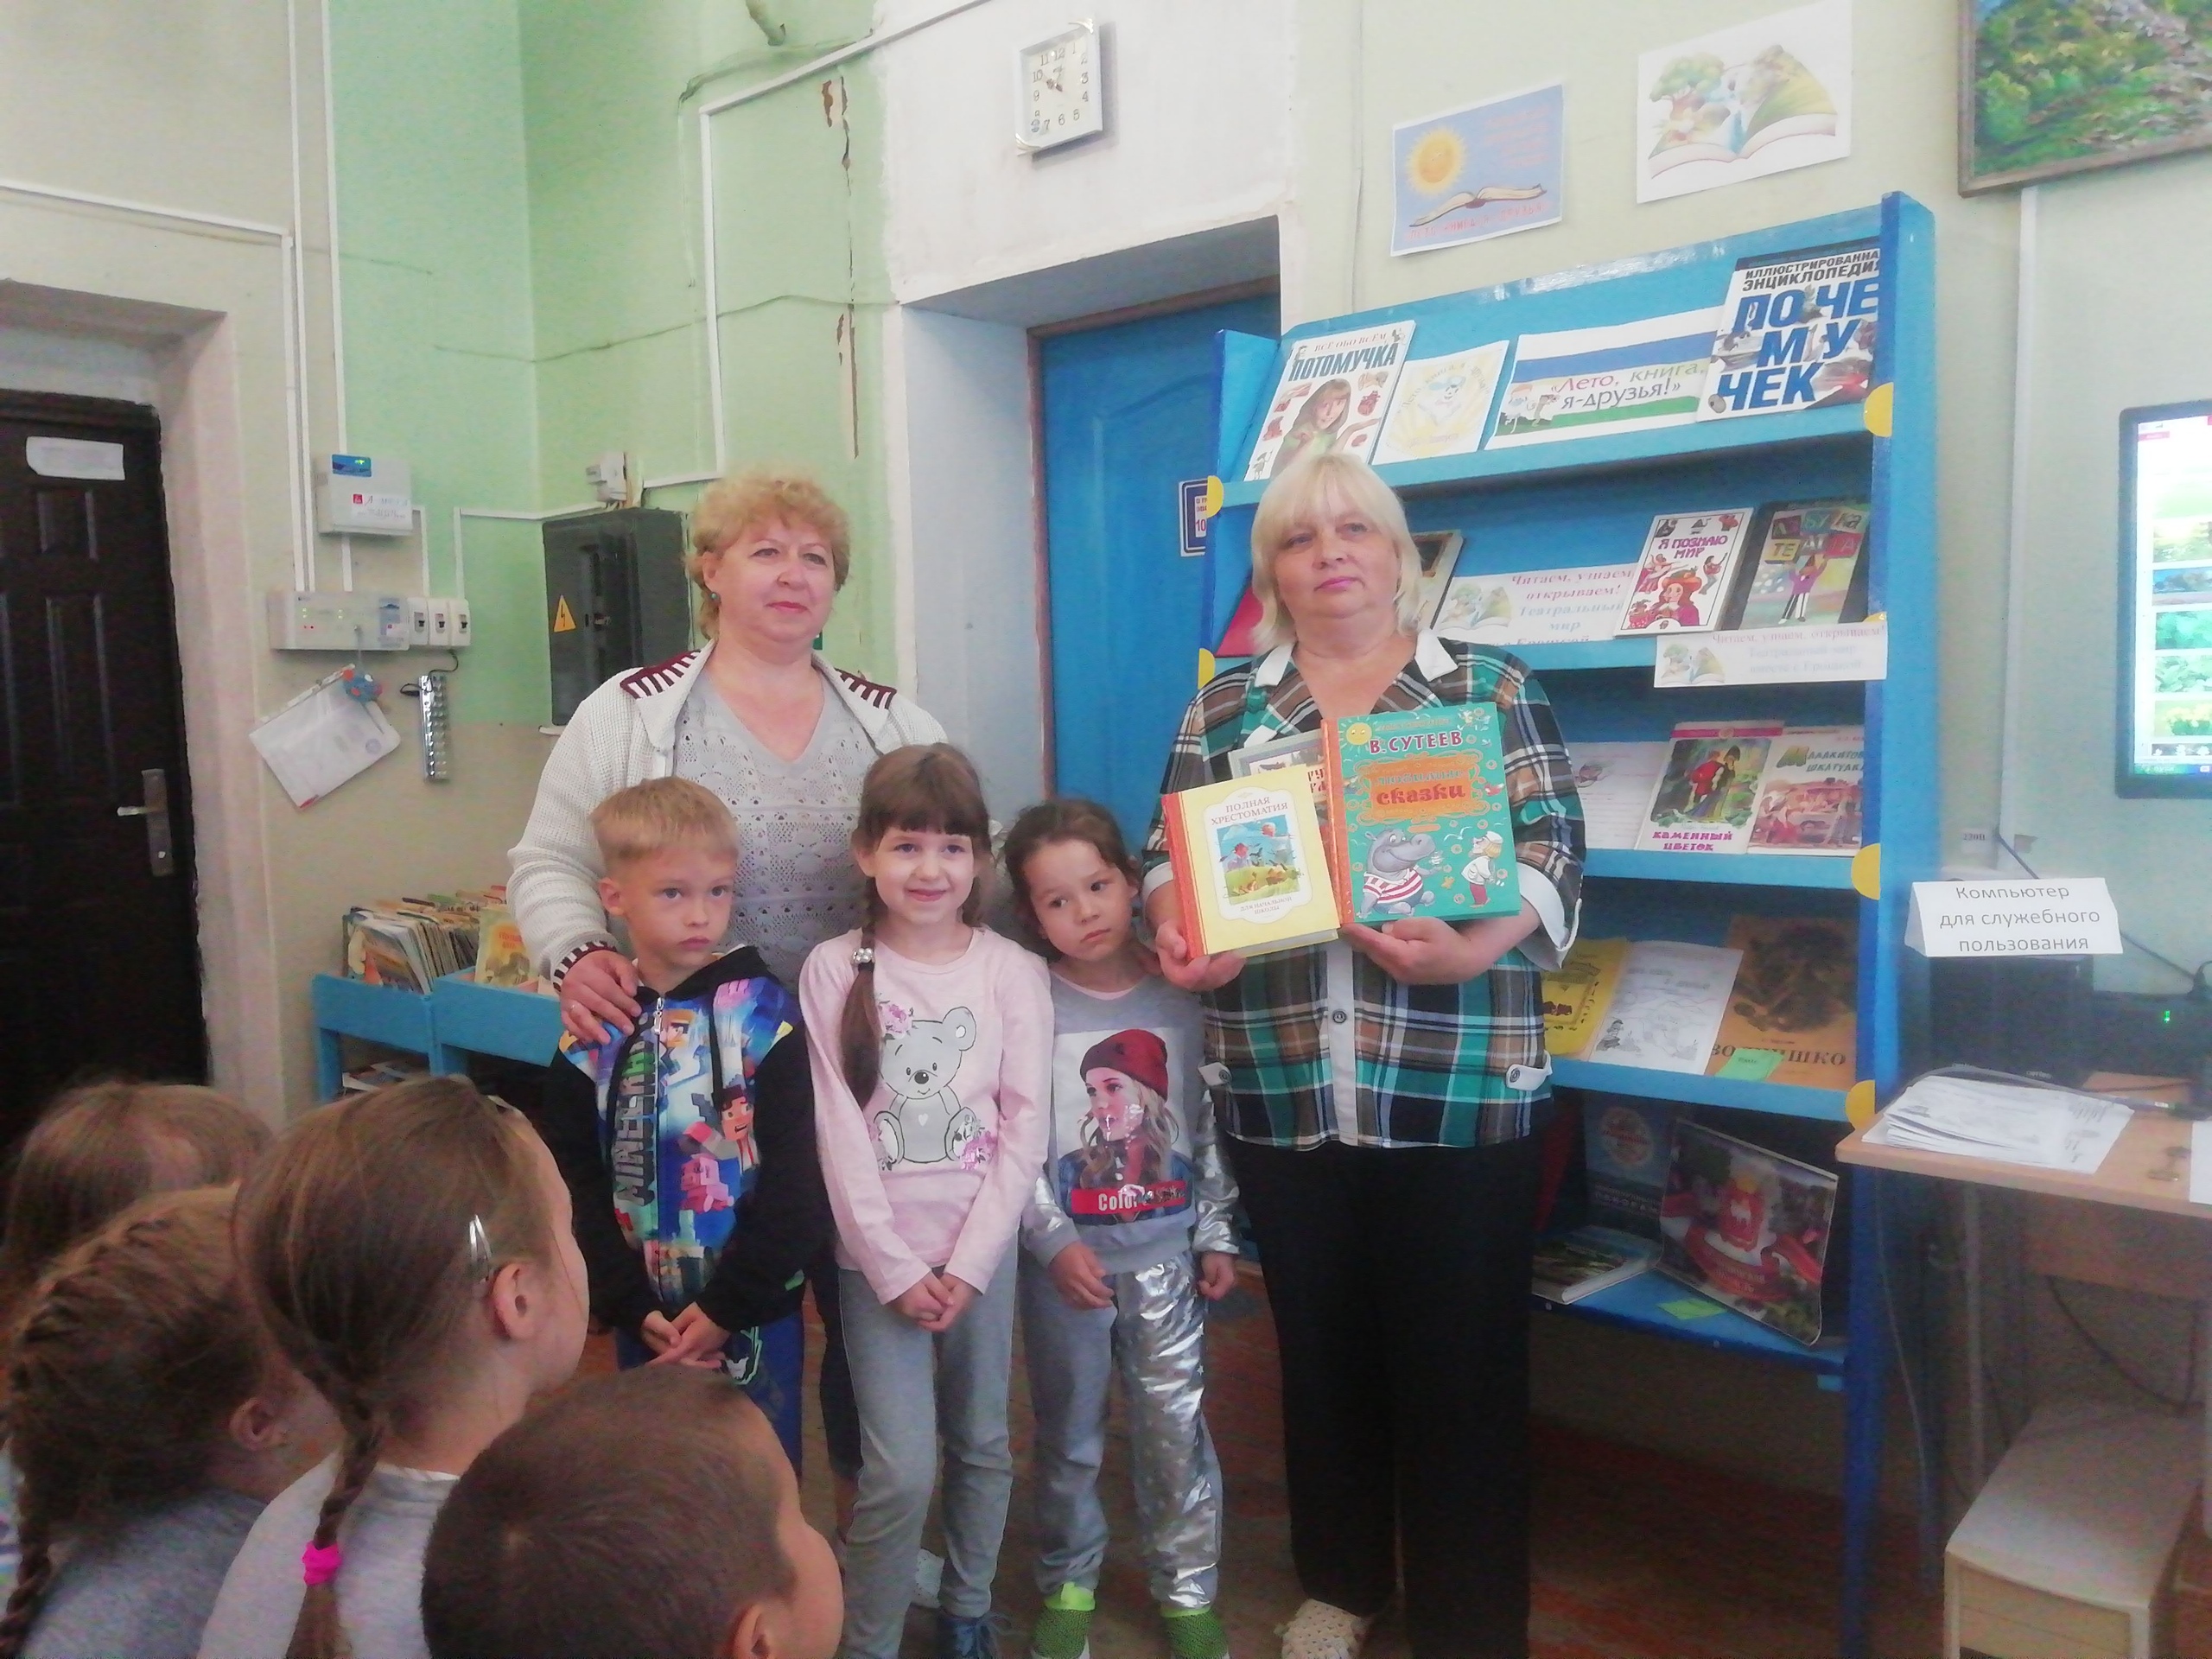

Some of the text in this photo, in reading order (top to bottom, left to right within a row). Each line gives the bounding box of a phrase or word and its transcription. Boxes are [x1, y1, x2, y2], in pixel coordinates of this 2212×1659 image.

[1053, 48, 1065, 61] 12
[1033, 69, 1043, 83] 10
[1081, 72, 1089, 85] 3
[1082, 91, 1089, 103] 4
[1745, 250, 1879, 279] ИЛЛЮСТРИРОВАННА
[1287, 343, 1399, 382] ПОТОМУЧКА
[1551, 363, 1706, 394] «Лето, книга,
[1717, 361, 1825, 411] ЧЕК
[1657, 538, 1670, 550] Я
[1673, 547, 1706, 559] МИР
[1806, 762, 1865, 772] ШКАТУЛК
[1376, 783, 1466, 805] сказки
[1225, 796, 1271, 813] ПОЛНАЯ
[1211, 802, 1288, 826] ХРЕСТОМАТИЯ
[1662, 842, 1714, 852] ЦВЕТОК
[1955, 887, 2069, 900] Компьютер
[1940, 909, 2101, 929] для служебного
[1959, 938, 2088, 952] пользования
